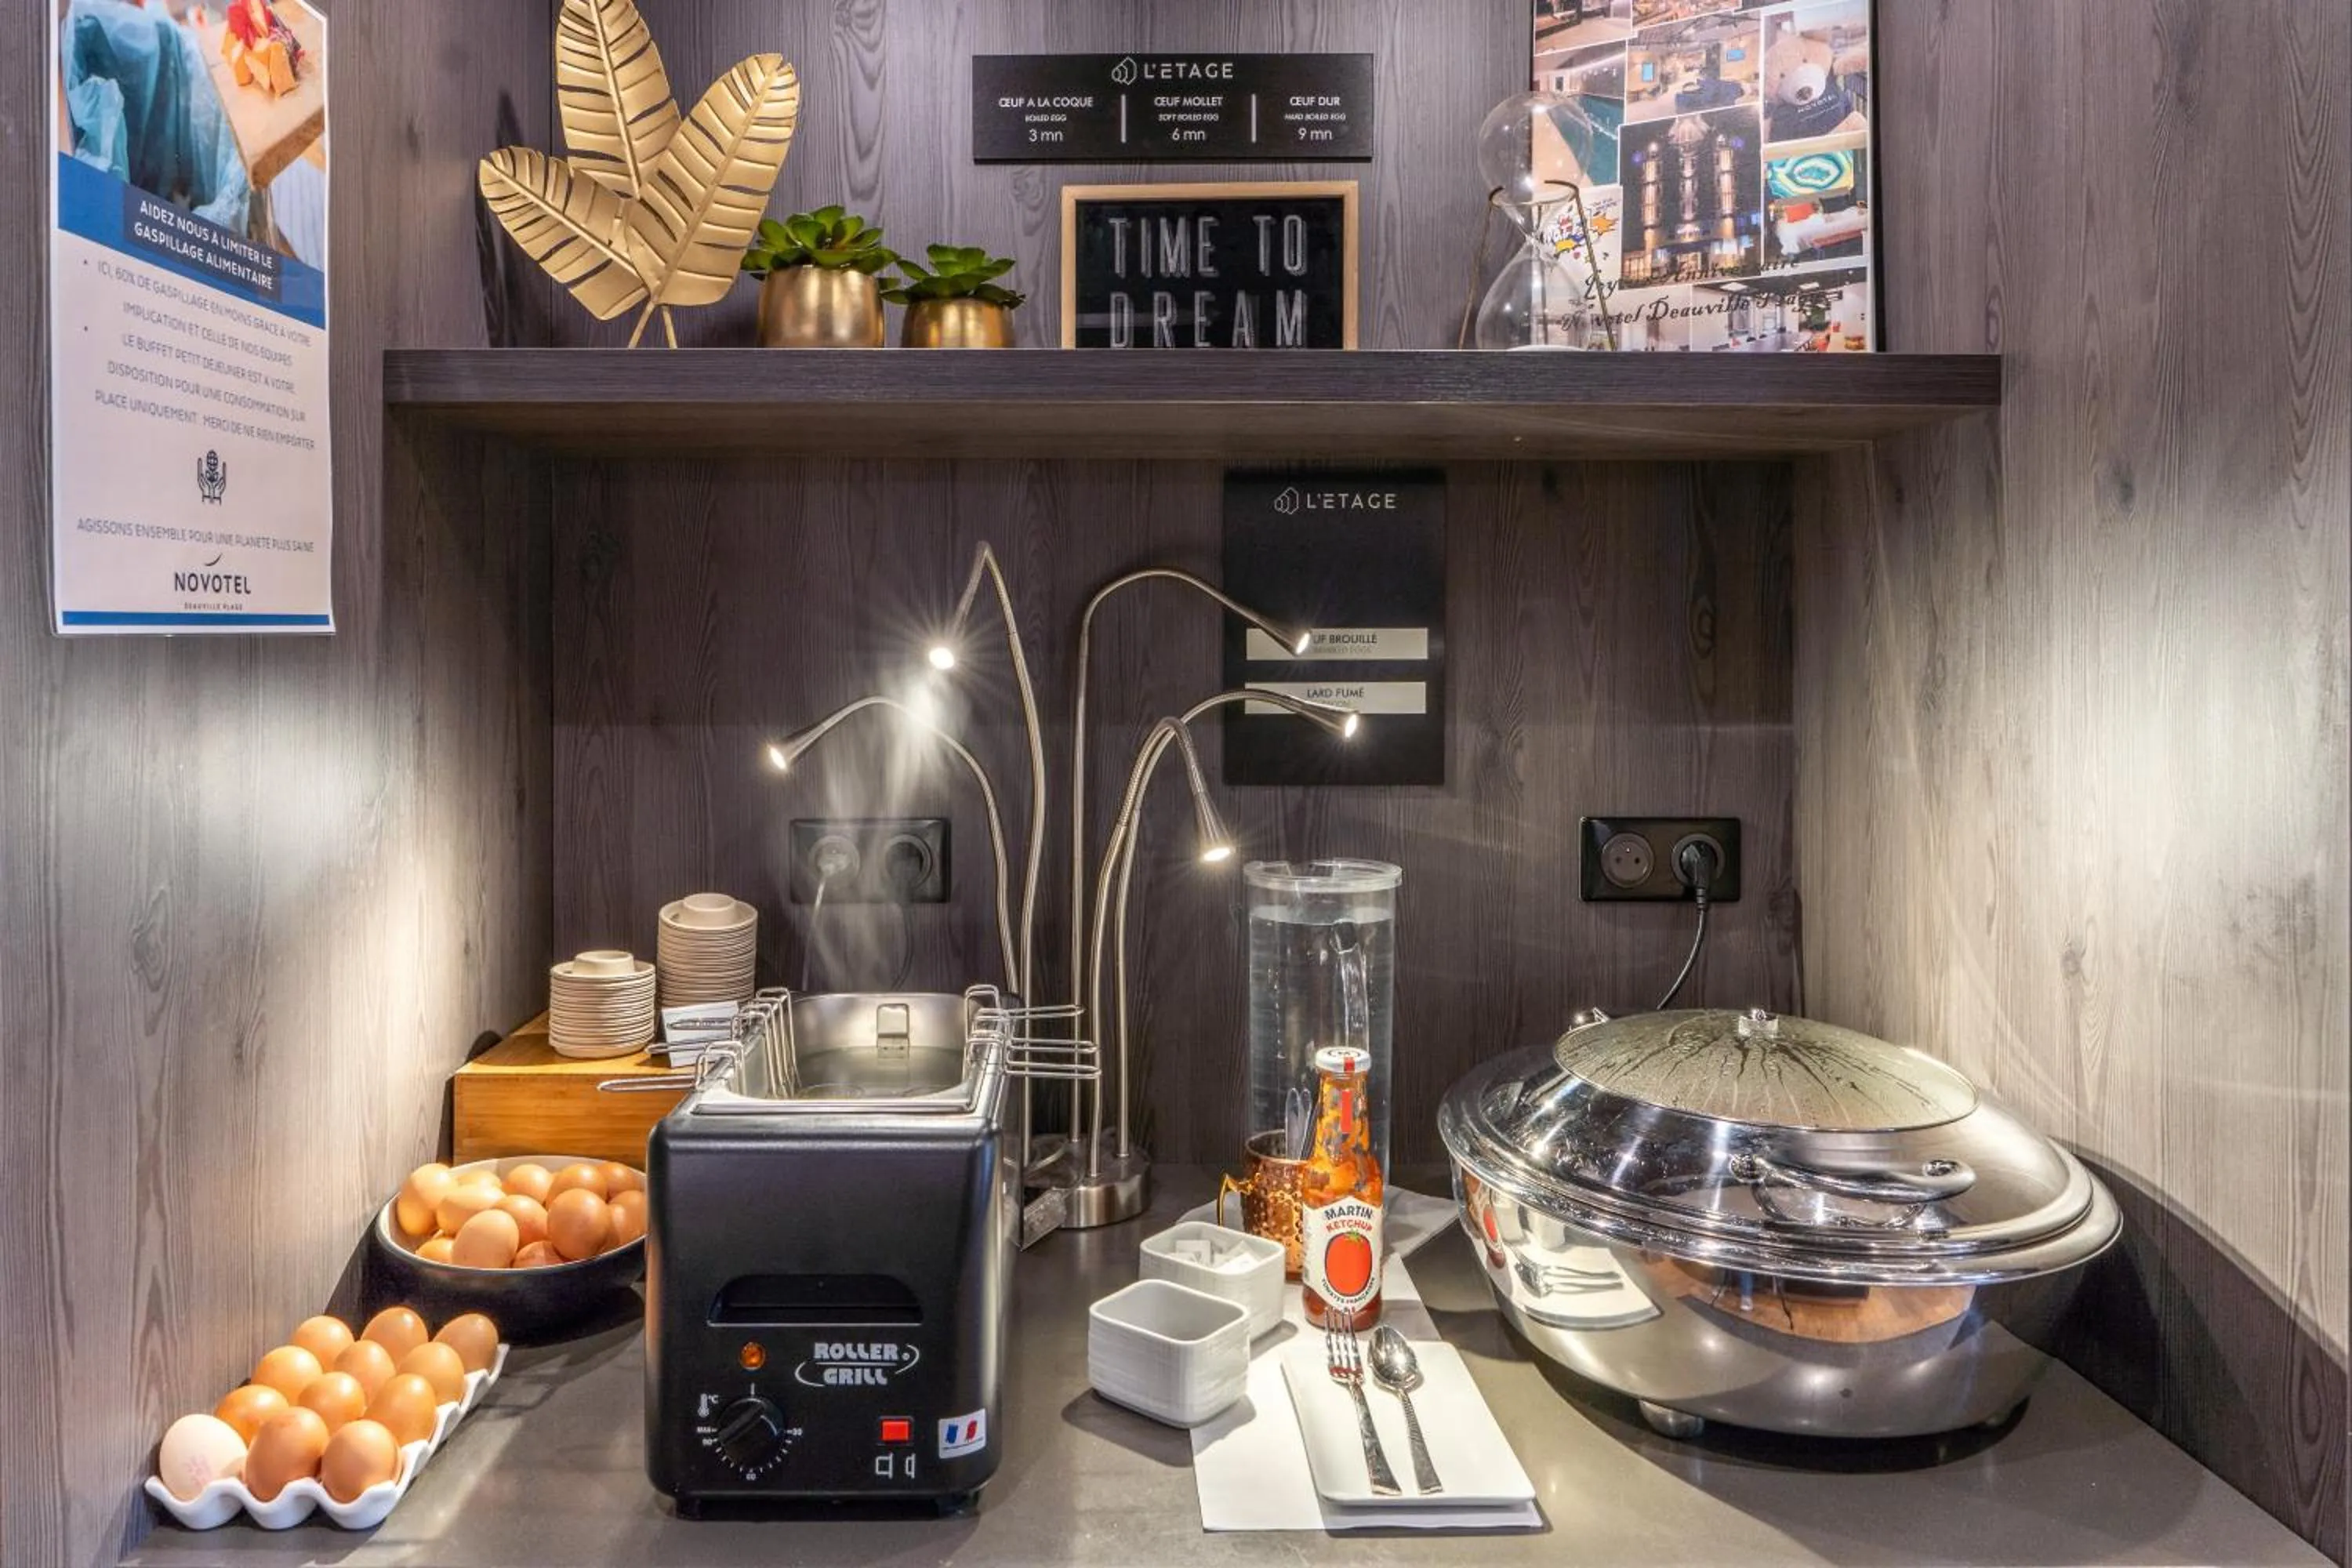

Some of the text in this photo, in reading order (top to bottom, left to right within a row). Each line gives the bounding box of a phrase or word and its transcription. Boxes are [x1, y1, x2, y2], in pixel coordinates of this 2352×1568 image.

[1144, 63, 1234, 79] L'ETAGE
[1037, 96, 1051, 107] LA
[1053, 96, 1094, 108] COQUE
[1182, 96, 1224, 107] MOLLET
[1318, 96, 1341, 106] DUR
[1029, 128, 1065, 142] 3 mn
[1172, 128, 1206, 141] 6 mn
[1298, 127, 1333, 140] 9 mn
[140, 200, 176, 227] AIDEZ
[176, 216, 210, 241] NOUS
[220, 238, 260, 264] LIMITER
[261, 253, 273, 270] LE
[1108, 214, 1308, 278] TIME TO
[134, 222, 274, 290] GASPILLAGE ALIMENTAIRE
[1646, 292, 1751, 322] Deauville
[1109, 289, 1308, 349] DREAM
[1307, 492, 1397, 510] L'ETAGE
[174, 572, 252, 595] NOVOTEL
[1306, 688, 1334, 699] LARD
[1323, 1204, 1374, 1221] MARTIN
[1326, 1219, 1373, 1233] KETCHUP
[813, 1341, 899, 1361] ROLLER
[823, 1367, 888, 1386] GRILL
